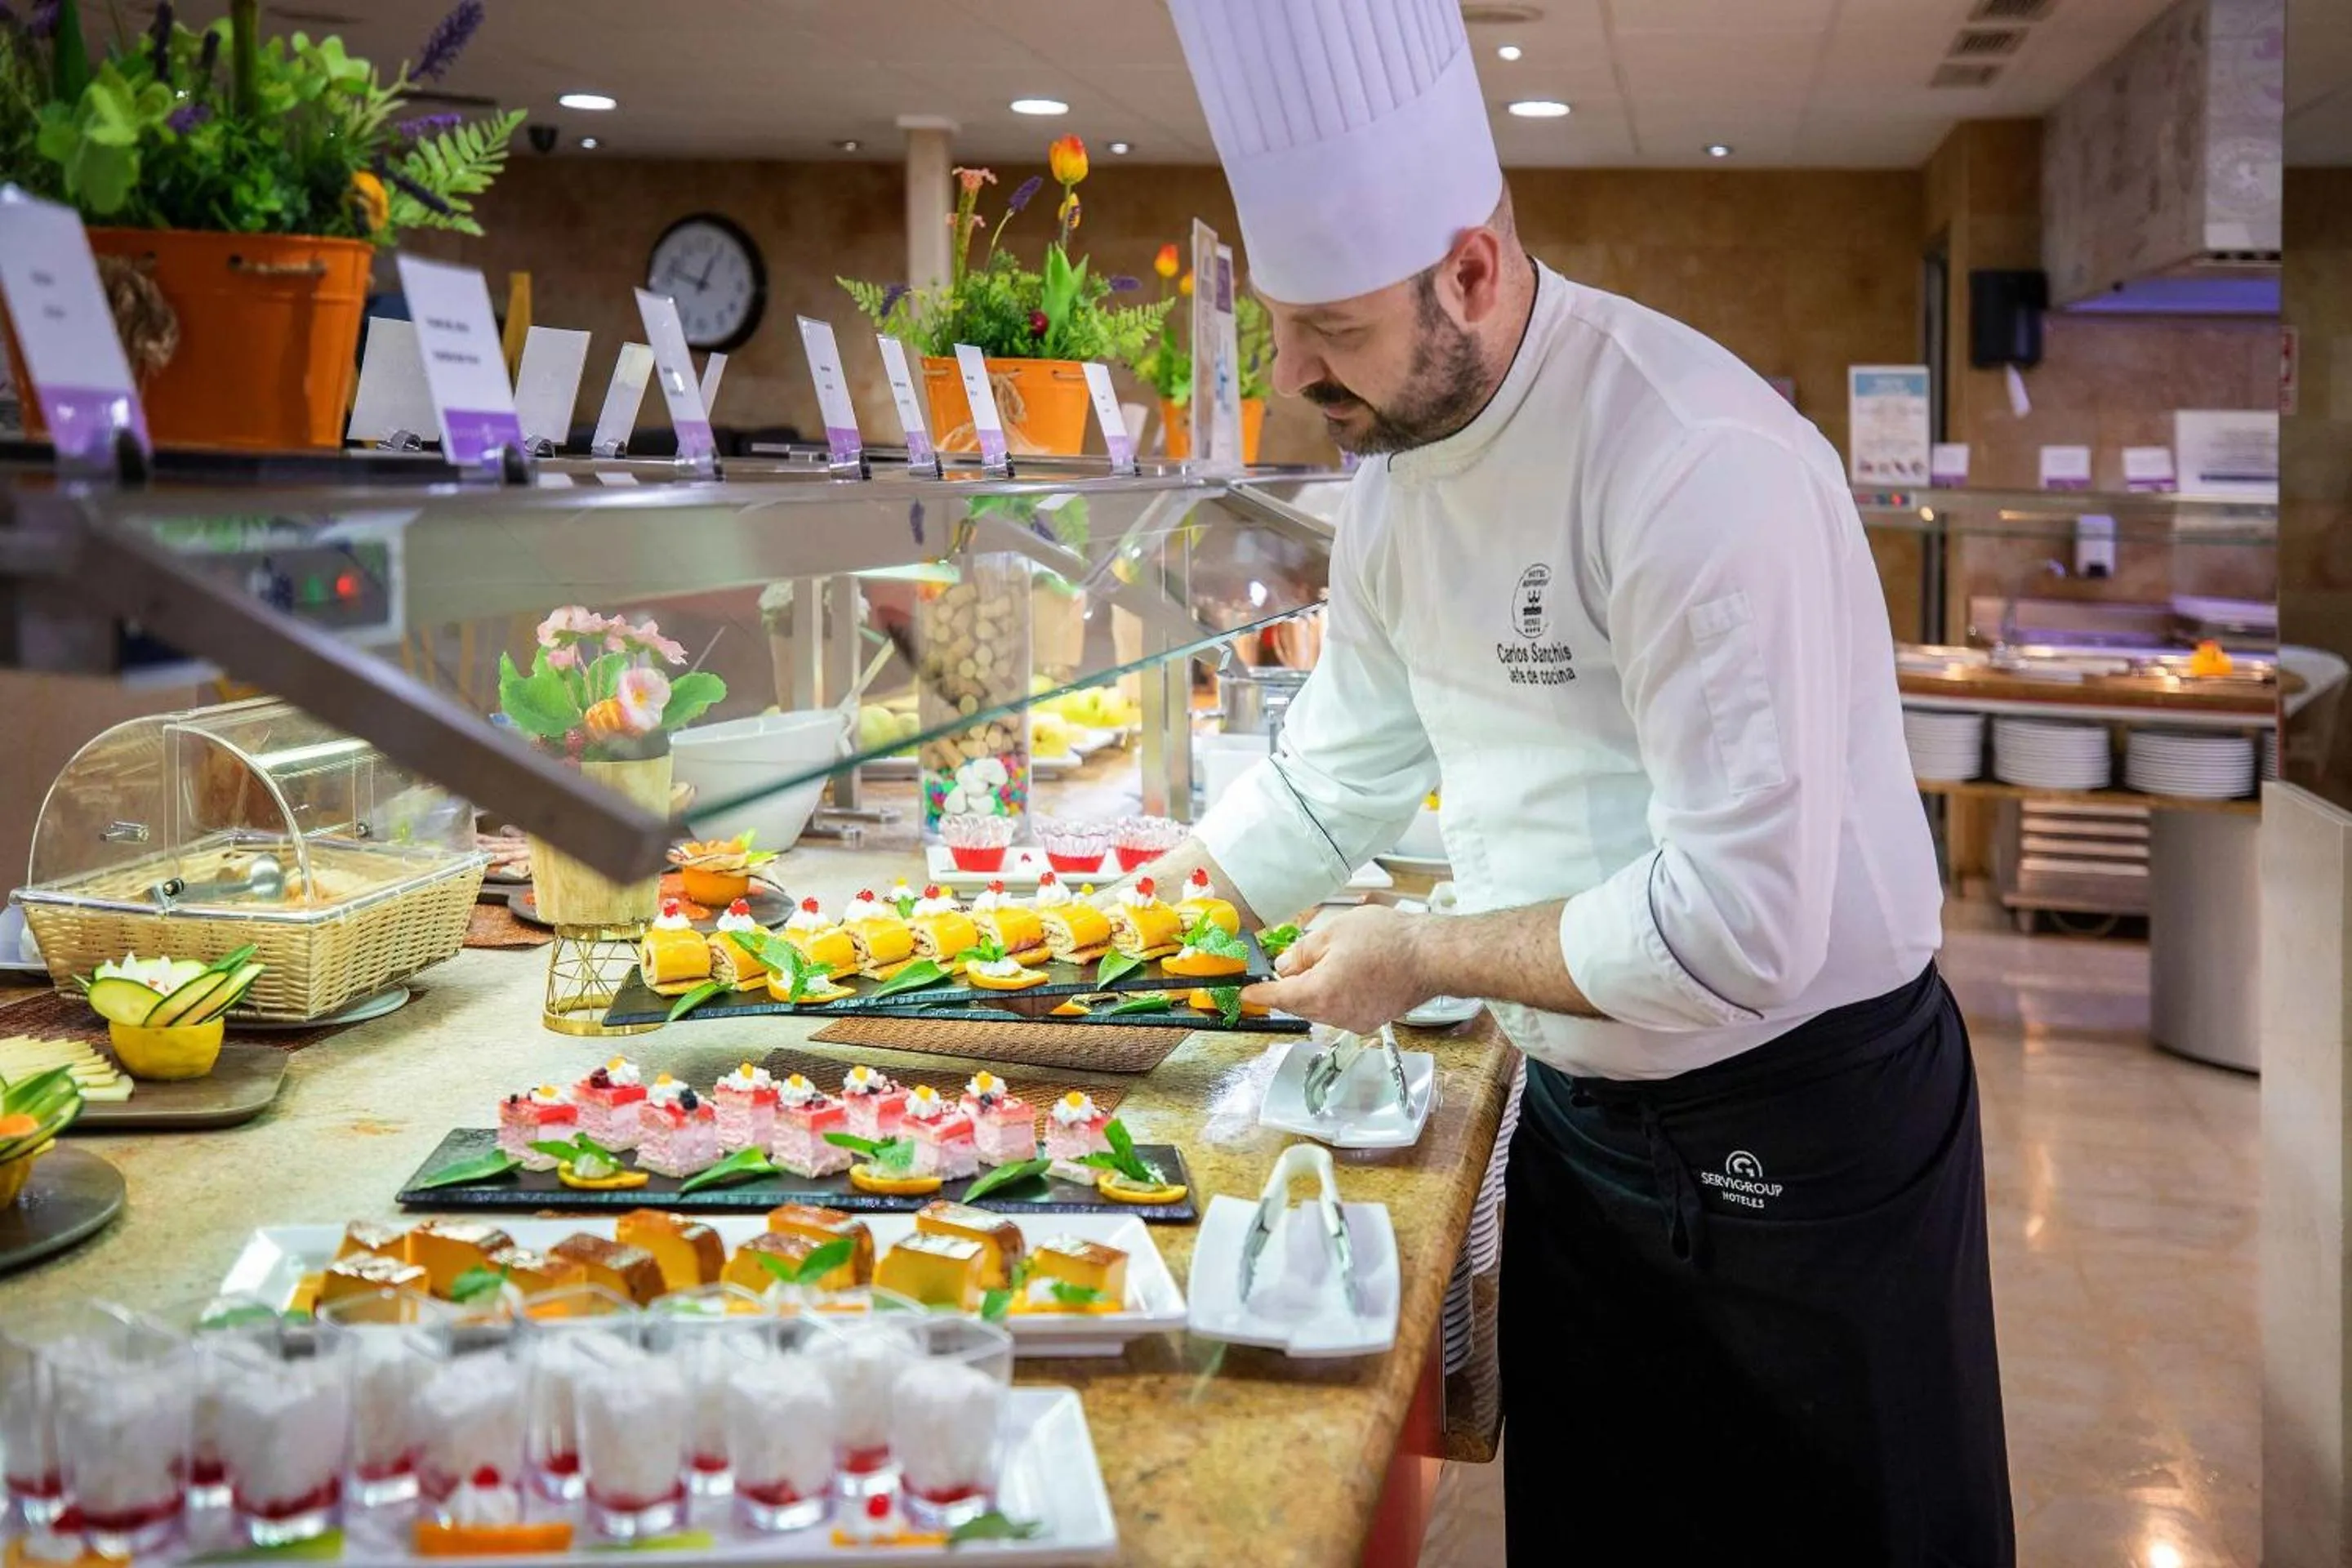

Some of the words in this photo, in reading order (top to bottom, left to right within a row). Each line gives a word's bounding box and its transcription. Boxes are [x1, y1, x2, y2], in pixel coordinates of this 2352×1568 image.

[1497, 643, 1529, 663] Carlos
[1531, 641, 1572, 663] Sanchis
[1527, 666, 1539, 684] de
[1540, 666, 1576, 684] cocina
[1701, 1172, 1783, 1196] SERVIGROUP
[1722, 1192, 1764, 1208] HOTELS
